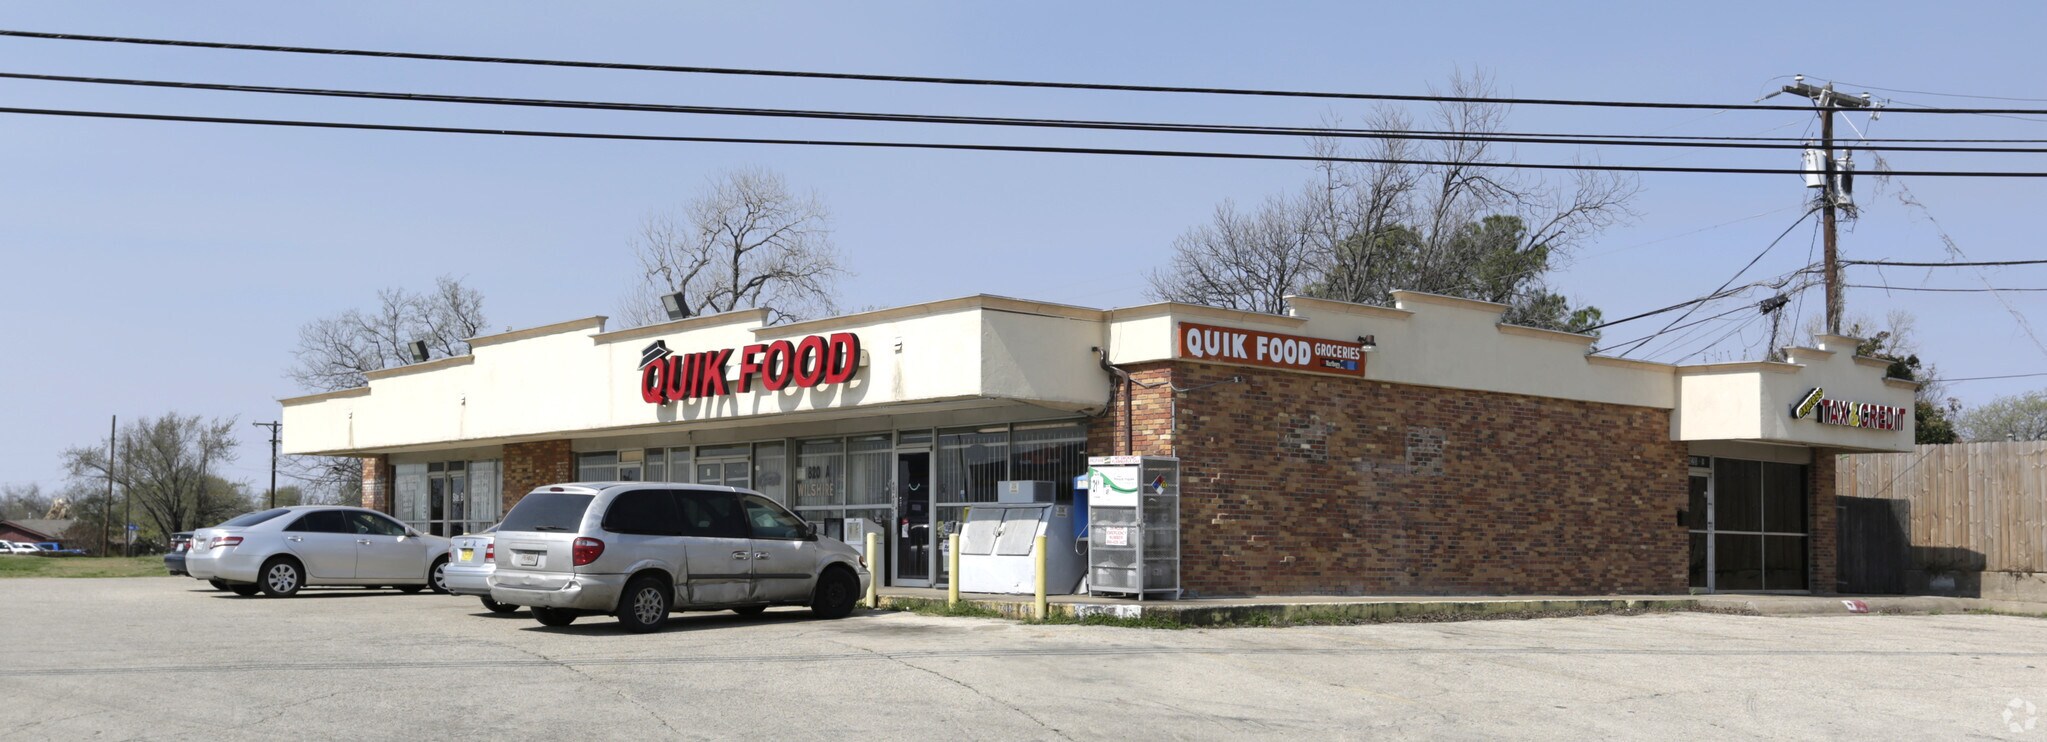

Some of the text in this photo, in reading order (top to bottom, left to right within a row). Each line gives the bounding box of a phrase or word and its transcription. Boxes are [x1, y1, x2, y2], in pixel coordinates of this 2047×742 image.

[1186, 328, 1361, 365] QUIK FOOD GROCERIES
[641, 332, 861, 405] QUIK FOOD
[1799, 388, 1823, 418] express
[1859, 402, 1906, 431] CREDIT
[797, 482, 834, 497] WILSHIRE
